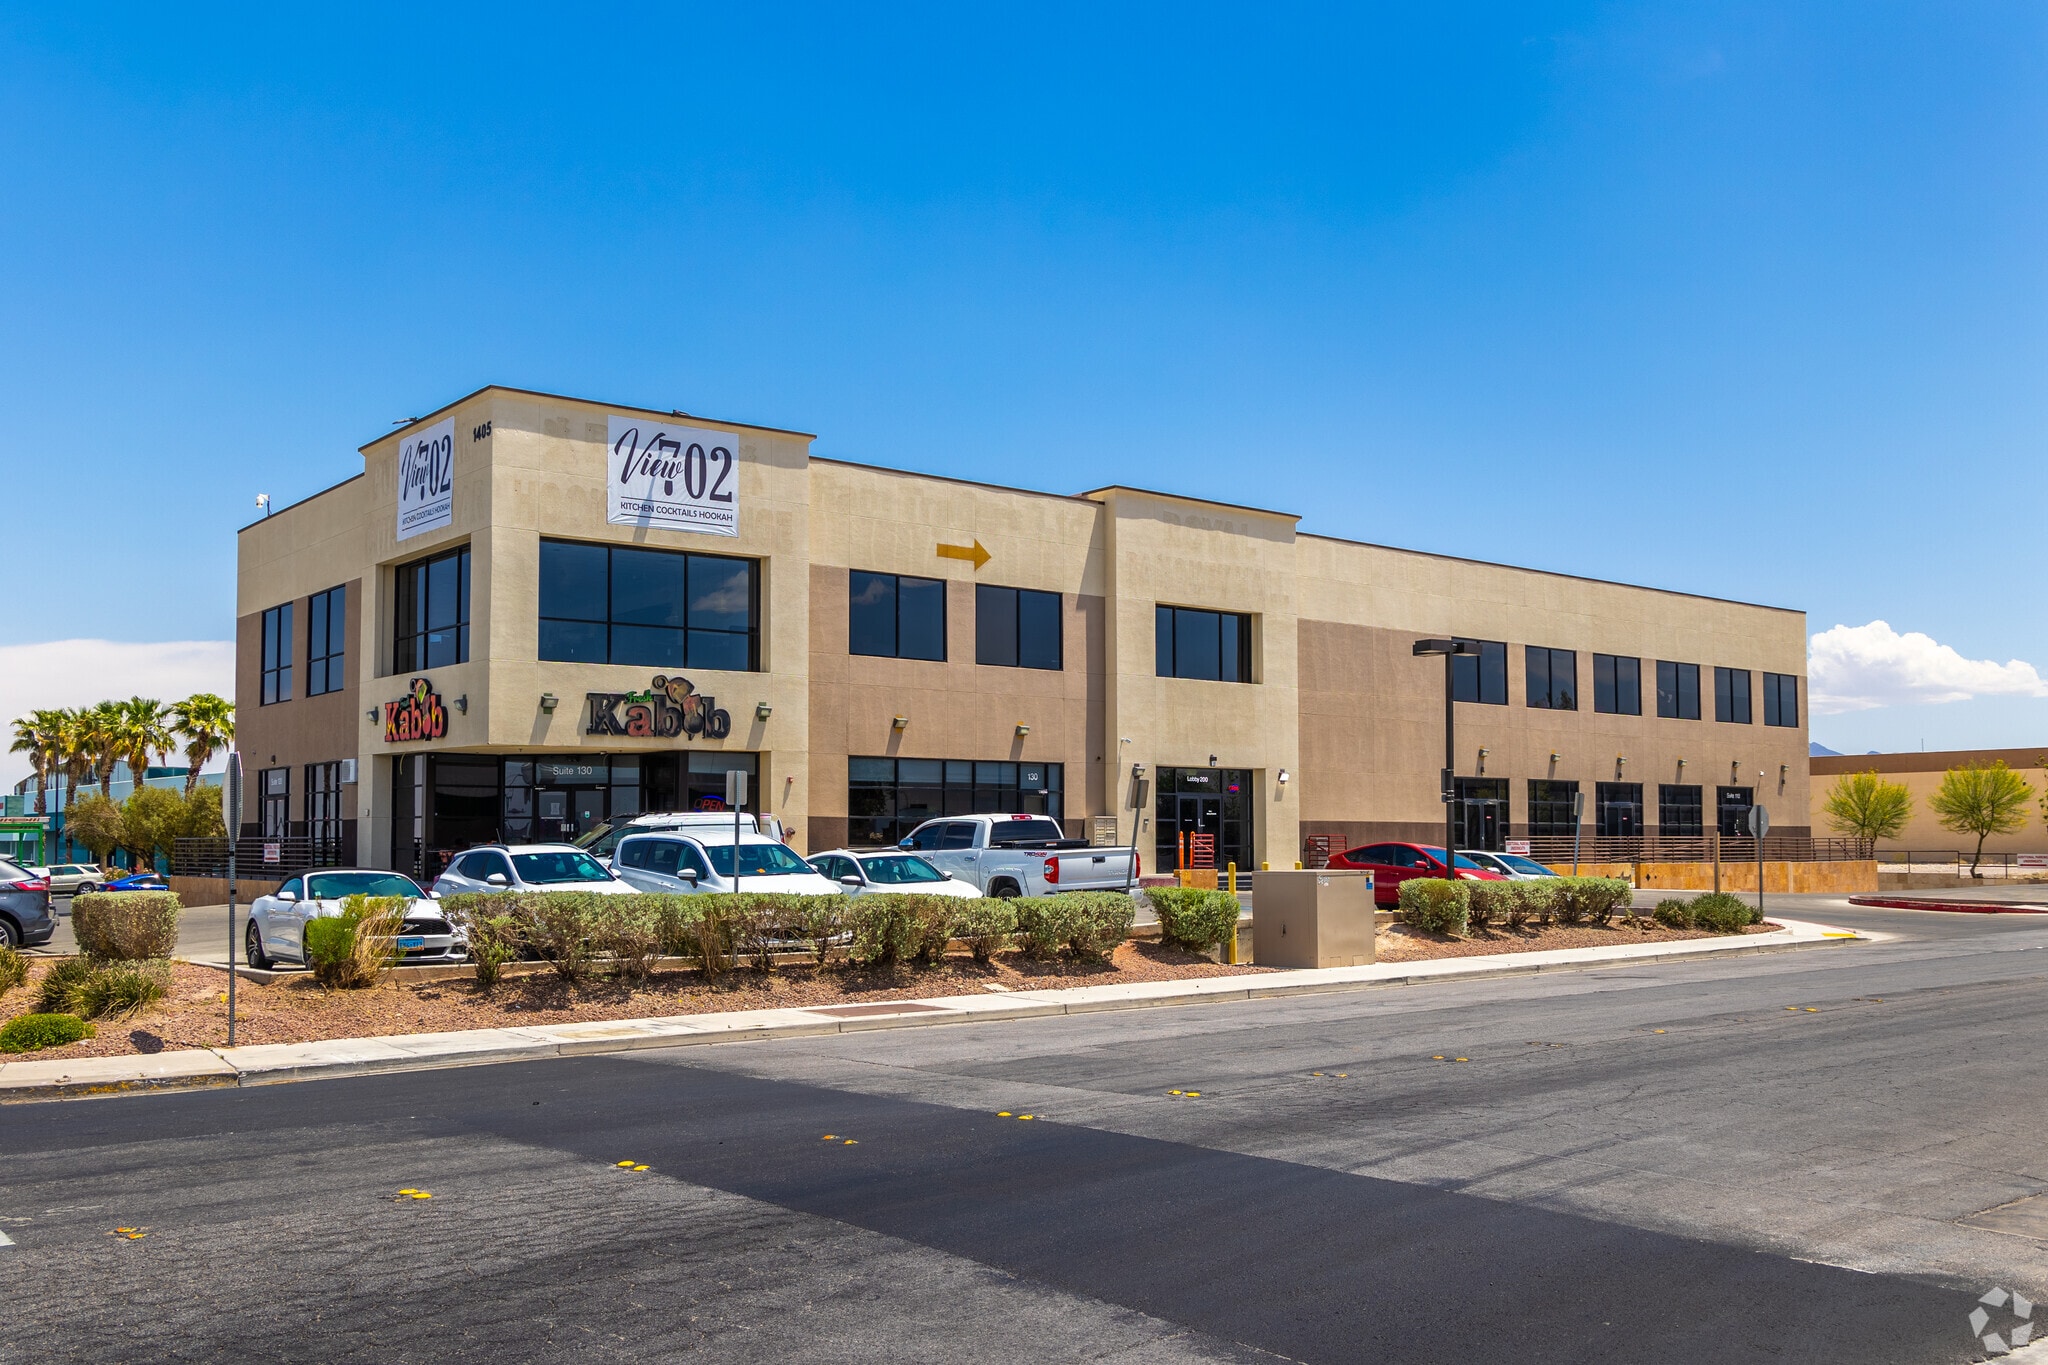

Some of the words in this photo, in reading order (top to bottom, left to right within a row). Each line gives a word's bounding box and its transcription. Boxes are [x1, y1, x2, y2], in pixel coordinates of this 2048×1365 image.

[473, 420, 492, 443] 1405
[401, 440, 429, 501] View
[419, 434, 452, 501] 702
[614, 427, 684, 485] View
[659, 438, 733, 503] 702
[434, 502, 450, 515] HOOKAH
[620, 501, 654, 513] KITCHEN
[656, 505, 697, 518] COCKTAILS
[699, 511, 733, 522] HOOKAH
[623, 688, 654, 704] Fresh
[586, 692, 732, 740] Kabob
[552, 766, 574, 776] Suite
[577, 765, 593, 775] 130
[1027, 772, 1039, 781] 130
[1186, 775, 1200, 783] Lobby
[693, 798, 726, 812] OPEN
